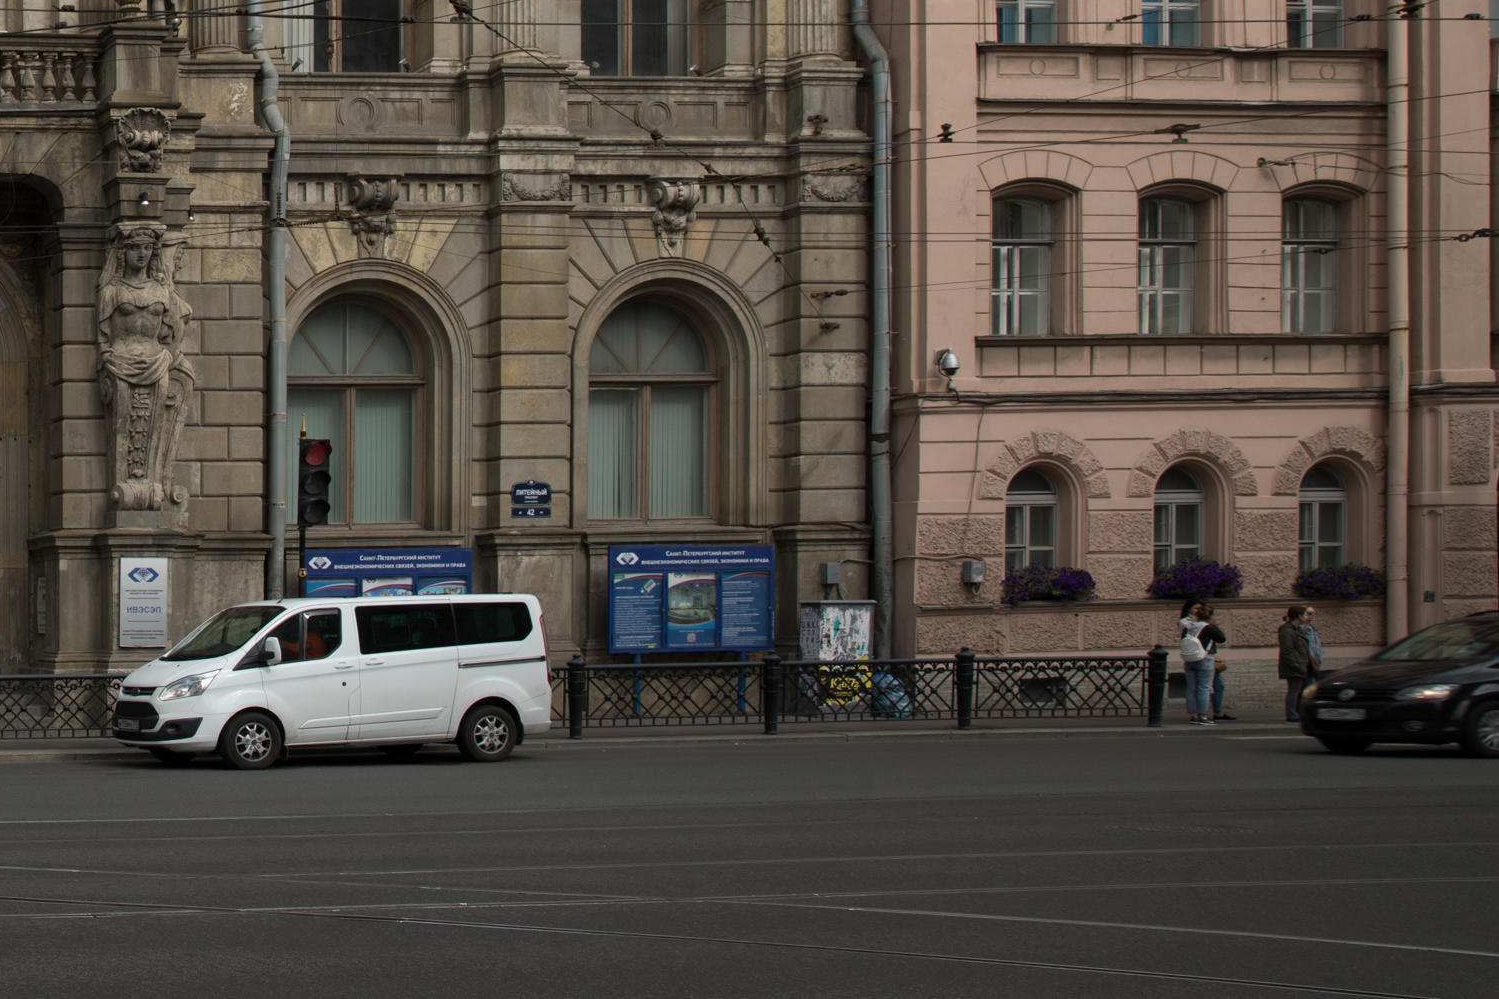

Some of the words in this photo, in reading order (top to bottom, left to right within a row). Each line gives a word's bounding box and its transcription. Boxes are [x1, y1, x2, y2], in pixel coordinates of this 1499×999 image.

[515, 488, 548, 496] ЛИТЕЙНЫЙ
[526, 508, 535, 516] 42
[126, 606, 162, 614] ИВЭСЭП
